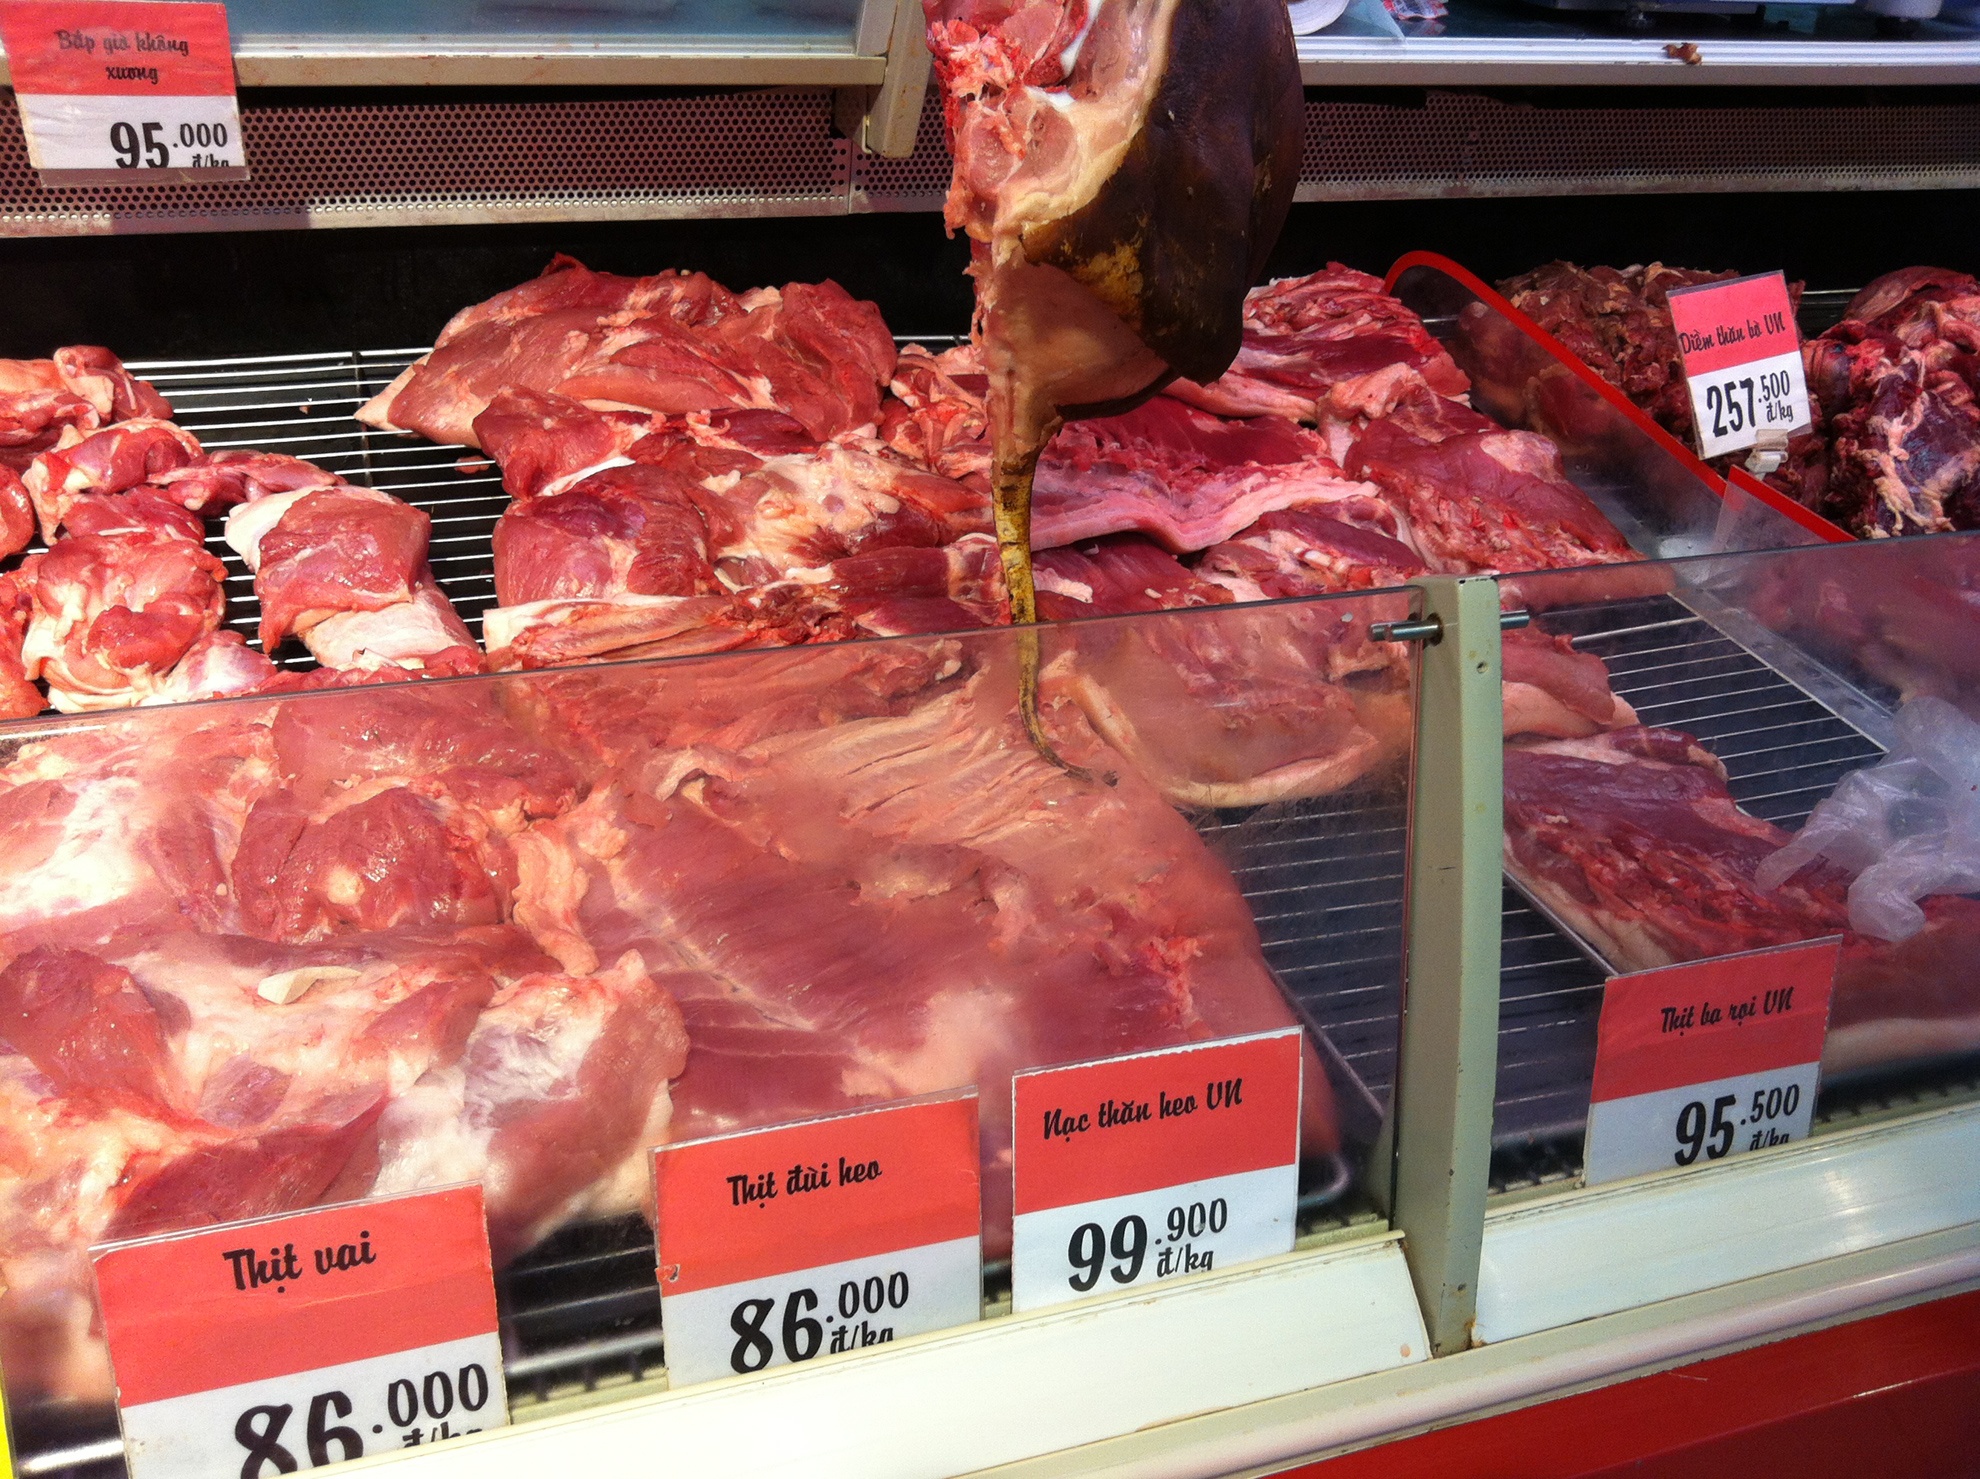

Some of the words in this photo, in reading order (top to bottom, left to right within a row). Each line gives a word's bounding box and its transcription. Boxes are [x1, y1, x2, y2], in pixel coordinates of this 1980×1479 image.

[136, 31, 189, 56] không
[110, 121, 228, 168] 95.000
[1716, 325, 1746, 346] thăn
[1746, 319, 1763, 339] bò
[1706, 370, 1790, 438] 257.500
[1766, 400, 1793, 424] đ/kg
[1661, 1004, 1694, 1037] Thịt
[1701, 1002, 1722, 1026] ba
[1728, 996, 1757, 1027] rọi
[1043, 1108, 1091, 1142] Nạc
[1098, 1099, 1153, 1128] thăn
[1159, 1091, 1198, 1119] heo
[1674, 1084, 1800, 1166] 95.500
[726, 1172, 778, 1209] Thịt
[786, 1163, 832, 1195] đùi
[839, 1157, 883, 1187] heo
[222, 1243, 302, 1293] Thịt
[314, 1230, 377, 1275] vai
[1067, 1198, 1228, 1292] 99.900
[1156, 1243, 1214, 1278] đ/kg
[730, 1271, 909, 1375] 86.000
[235, 1363, 489, 1479] 86.000
